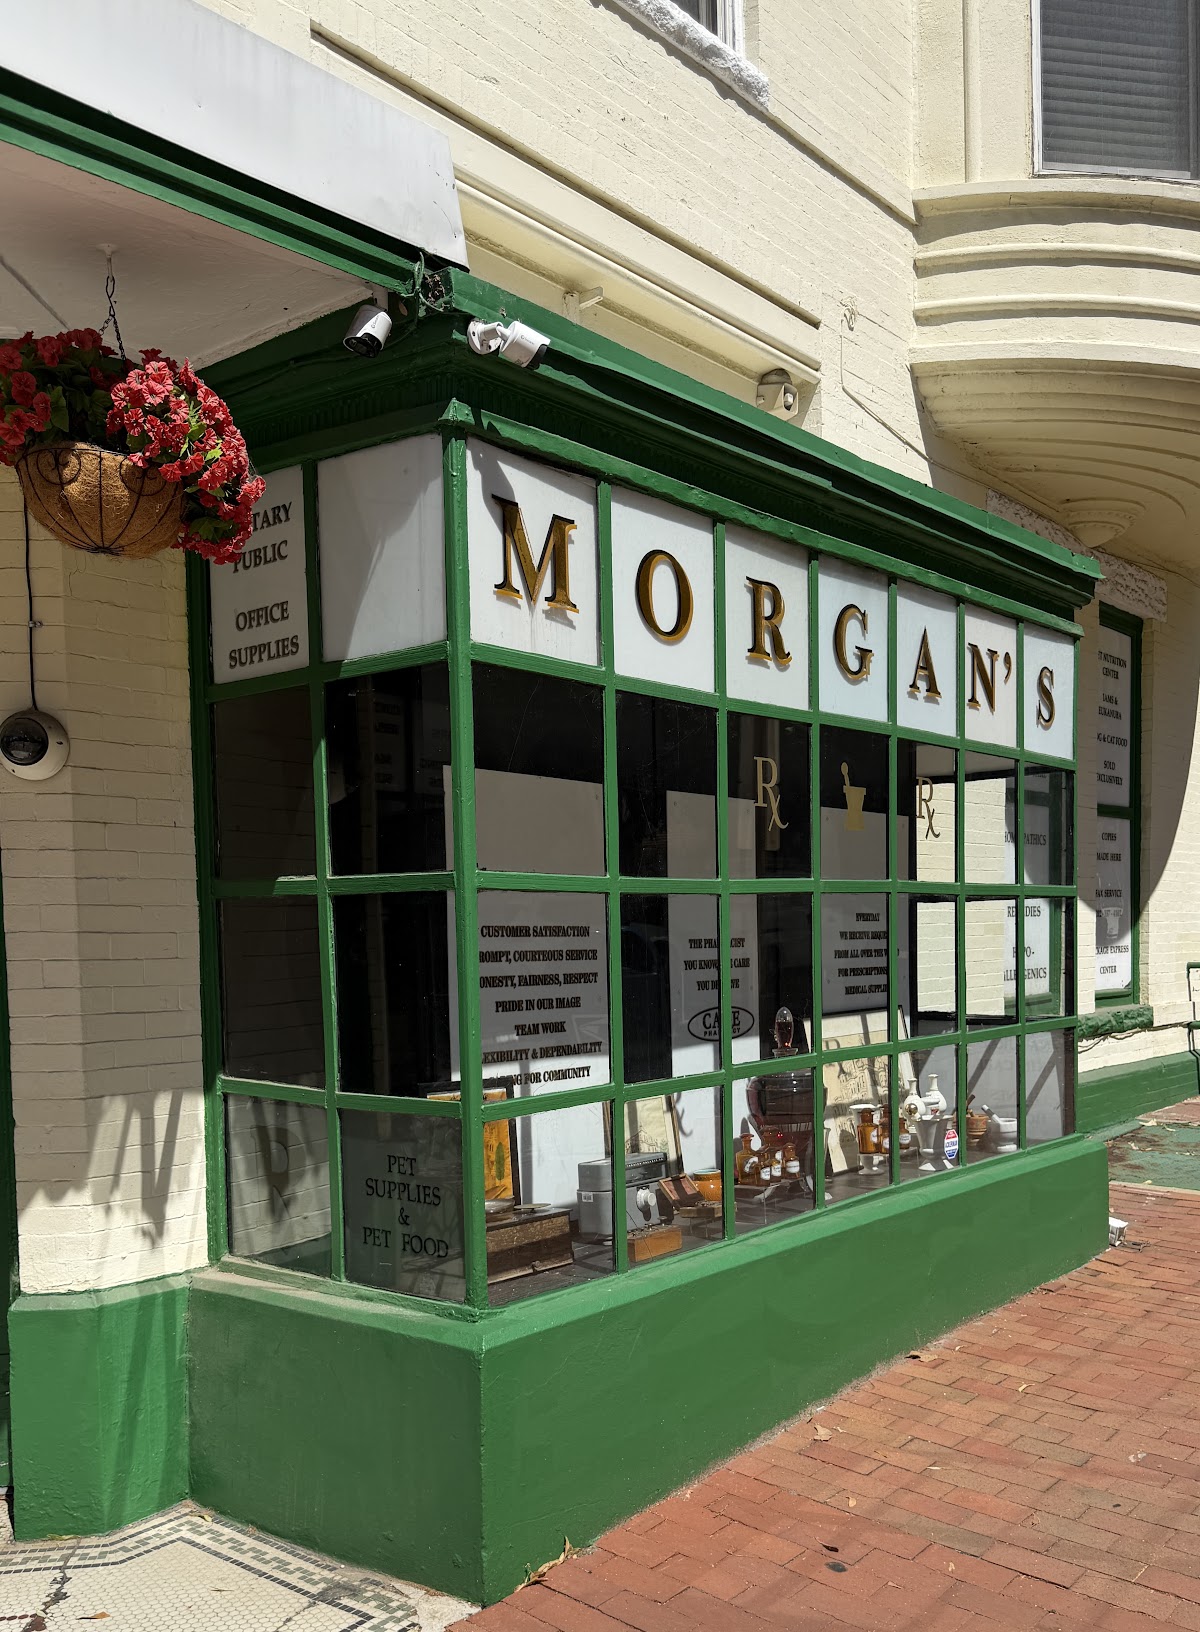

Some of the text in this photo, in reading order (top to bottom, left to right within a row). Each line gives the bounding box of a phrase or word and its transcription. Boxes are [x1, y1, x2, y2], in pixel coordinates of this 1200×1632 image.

[250, 502, 292, 531] TARY
[233, 540, 288, 573] PUBLIC
[235, 600, 289, 631] OFFICE
[492, 493, 1055, 731] MORGAN'S
[229, 635, 299, 669] SUPPLIES
[1102, 652, 1127, 669] NUTRITION
[1102, 666, 1119, 680] CENTER
[1106, 735, 1116, 745] CAT
[1115, 737, 1128, 747] FOOD
[1103, 760, 1116, 771] SOLD
[1101, 832, 1117, 841] COPIES
[1096, 852, 1122, 862] MADE HERE
[1095, 889, 1122, 898] FAX SERVICE
[855, 912, 880, 922] EVERYDAY
[1007, 905, 1042, 918] REDIES
[480, 925, 590, 938] CUSTOMER SATISFACTION
[839, 931, 848, 941] WE
[848, 930, 870, 941] RECEIVE
[688, 937, 746, 949] THE PHACIST
[1109, 945, 1129, 954] EXPRESS
[479, 949, 598, 965] ROMPT, COURTEOUS SERVICE
[834, 949, 849, 960] FROM
[849, 949, 860, 959] ALL
[860, 948, 873, 959] OVER
[873, 948, 884, 958] THE
[683, 960, 698, 971] YOU
[733, 957, 750, 969] CARE
[1099, 965, 1117, 975] CENTER
[837, 966, 888, 978] FOR PRESCRIPTIONS
[479, 972, 599, 989] ONESTY, FAIRNESS, RESPECT
[696, 980, 709, 992] YOU
[844, 985, 867, 996] MEDICAL
[495, 996, 582, 1013] PRIDE IN OUR IMAGE
[702, 1010, 741, 1030] CAE
[514, 1021, 567, 1037] TEAM WORK
[703, 1027, 741, 1037] PHACY
[482, 1041, 603, 1064] EXIBILITY & DEPENDABILITY
[524, 1072, 542, 1085] FOR
[542, 1065, 592, 1083] COMMUNITY
[387, 1154, 417, 1177] PET
[365, 1177, 441, 1207] SUPPLIES
[397, 1207, 410, 1226] &
[362, 1226, 450, 1259] PET FOOD
